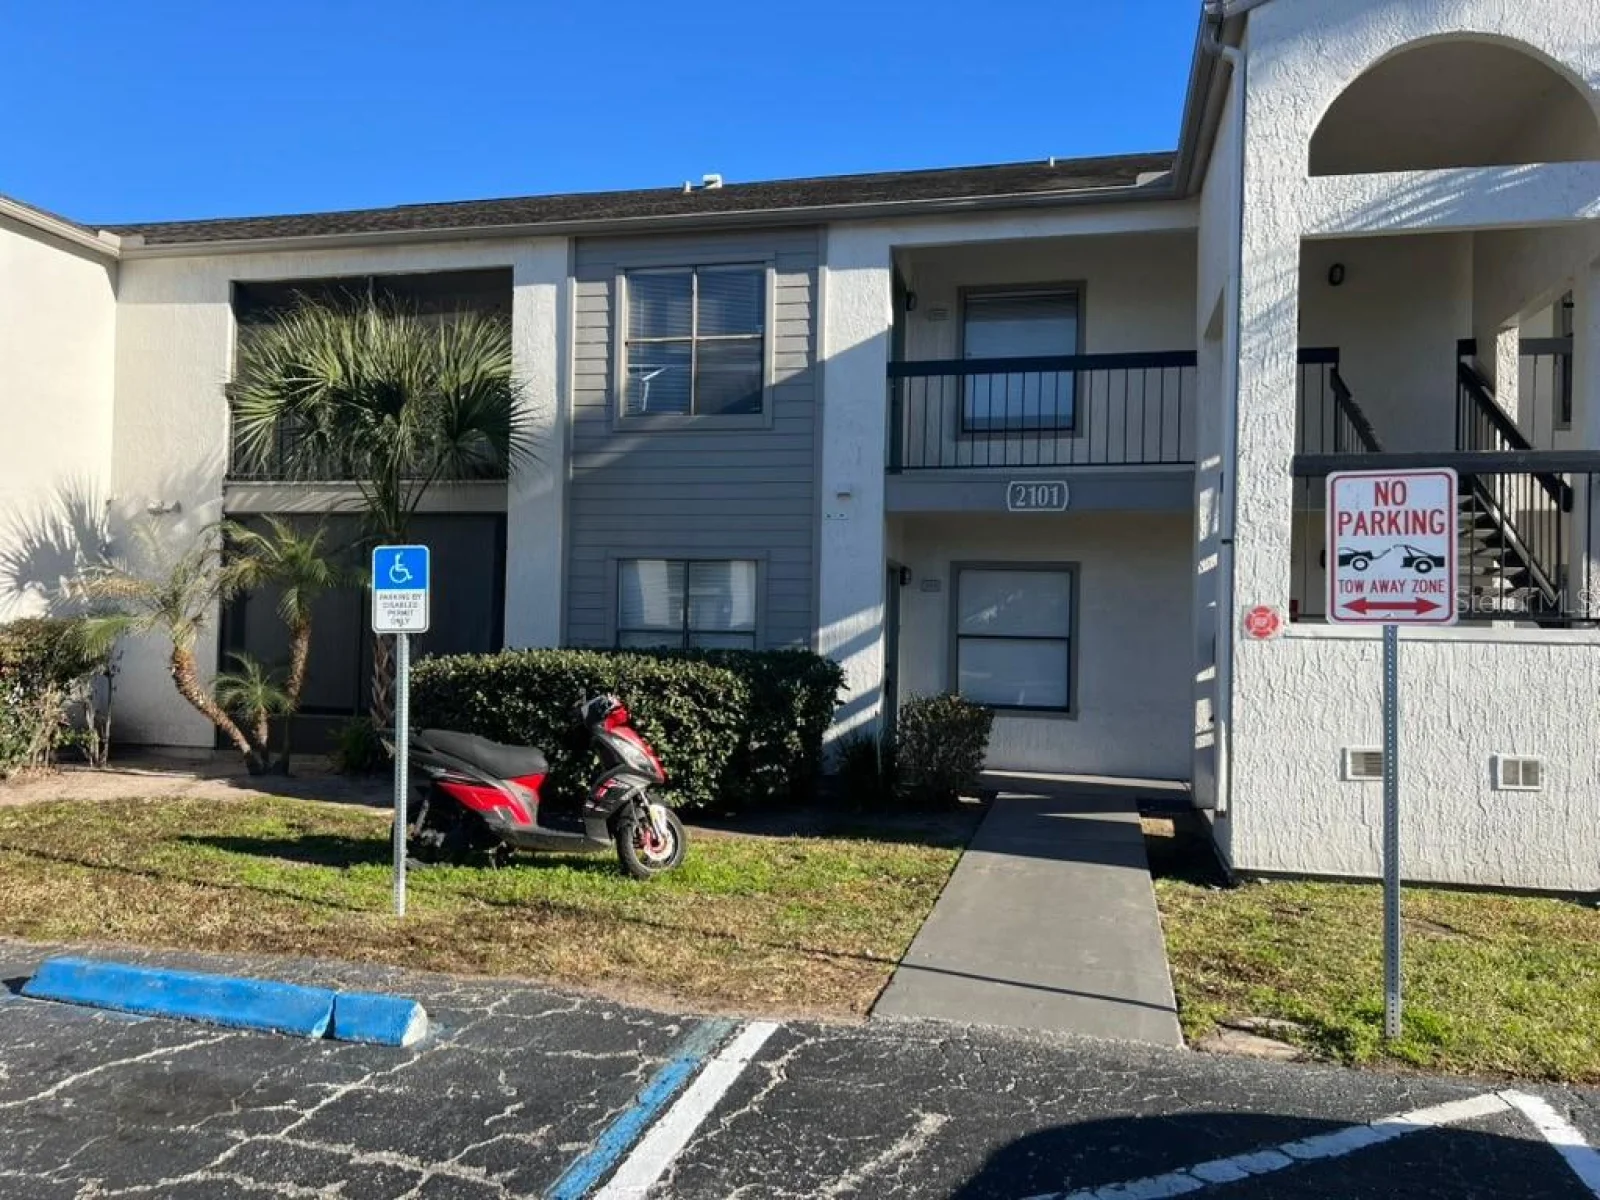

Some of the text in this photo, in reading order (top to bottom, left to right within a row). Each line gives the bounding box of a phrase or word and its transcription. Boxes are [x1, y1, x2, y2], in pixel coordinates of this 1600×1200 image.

[1016, 485, 1058, 506] 2101
[1374, 480, 1407, 507] NO
[1338, 509, 1445, 537] PARKING
[1338, 579, 1445, 594] TOW AWAY ZONE
[379, 593, 422, 601] PARKING BY
[382, 601, 418, 609] DISABLED
[387, 609, 413, 617] PERMIT
[390, 617, 411, 625] ONLY
